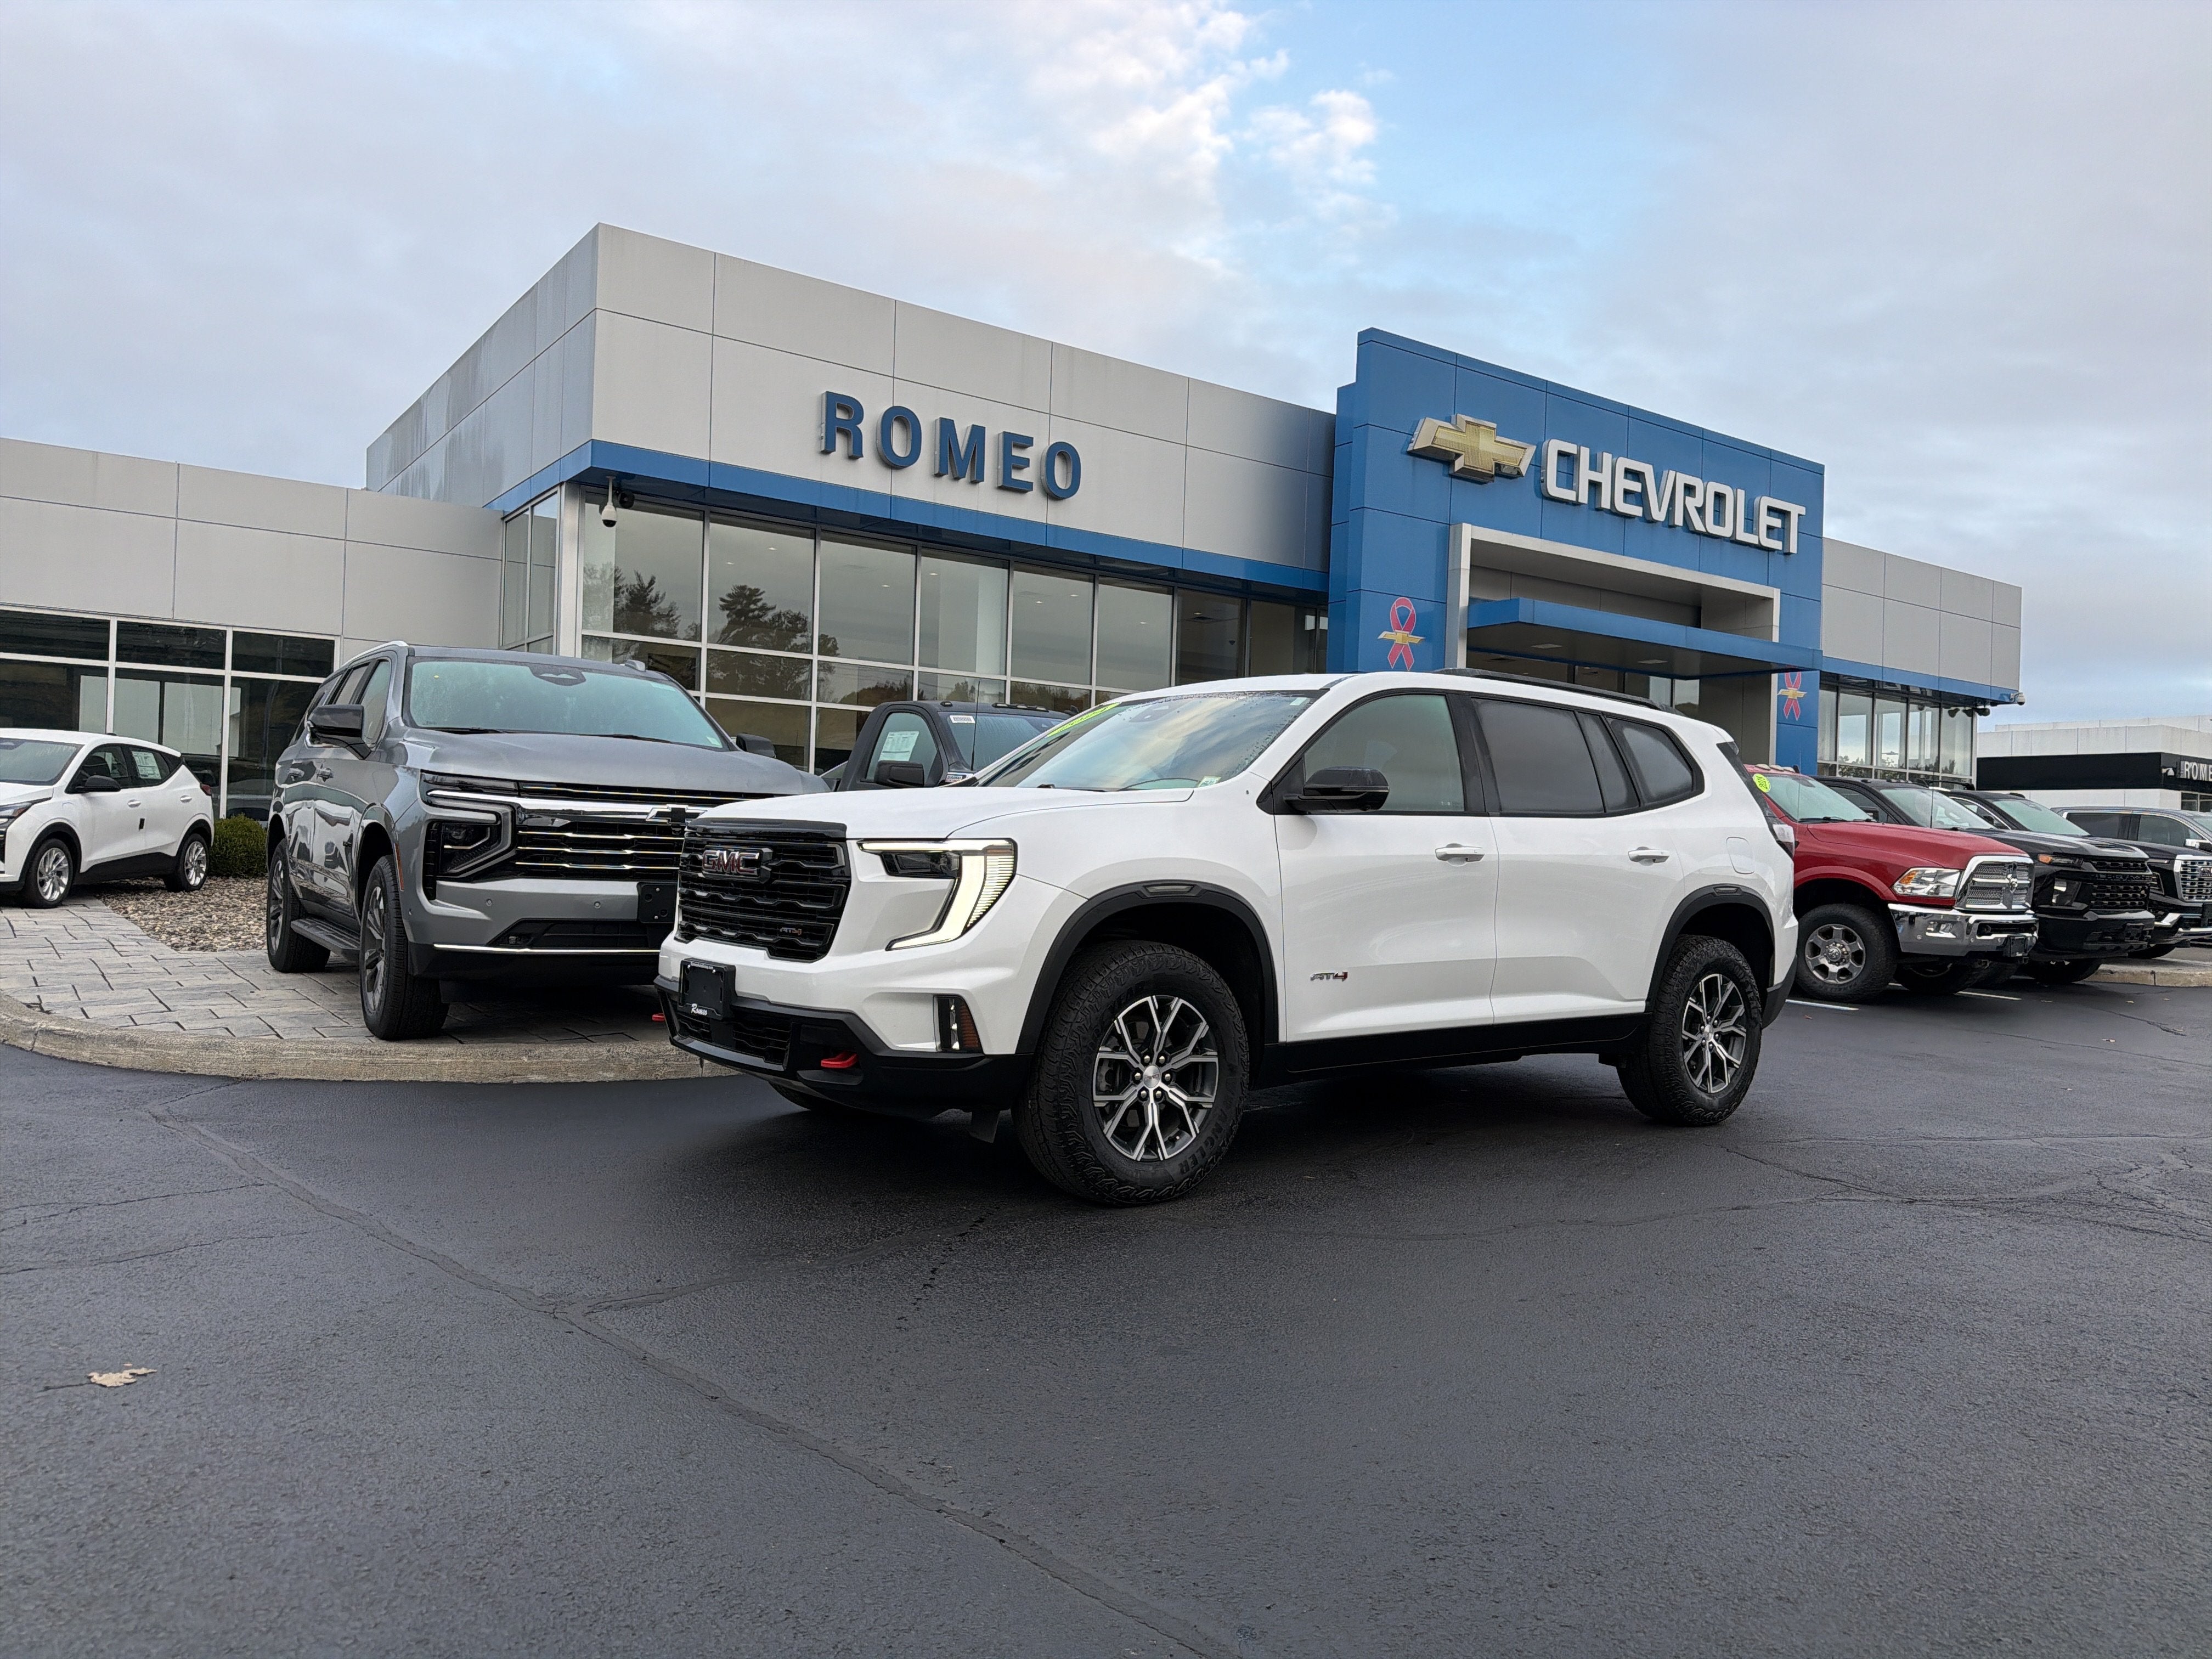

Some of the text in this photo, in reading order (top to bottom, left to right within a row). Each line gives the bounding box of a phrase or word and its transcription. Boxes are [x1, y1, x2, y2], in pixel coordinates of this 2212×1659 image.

[821, 391, 1081, 499] ROMEO
[1542, 439, 1805, 554] CHEVROLET
[702, 850, 760, 876] GMC
[780, 927, 802, 935] AT4
[1310, 971, 1348, 982] AT4
